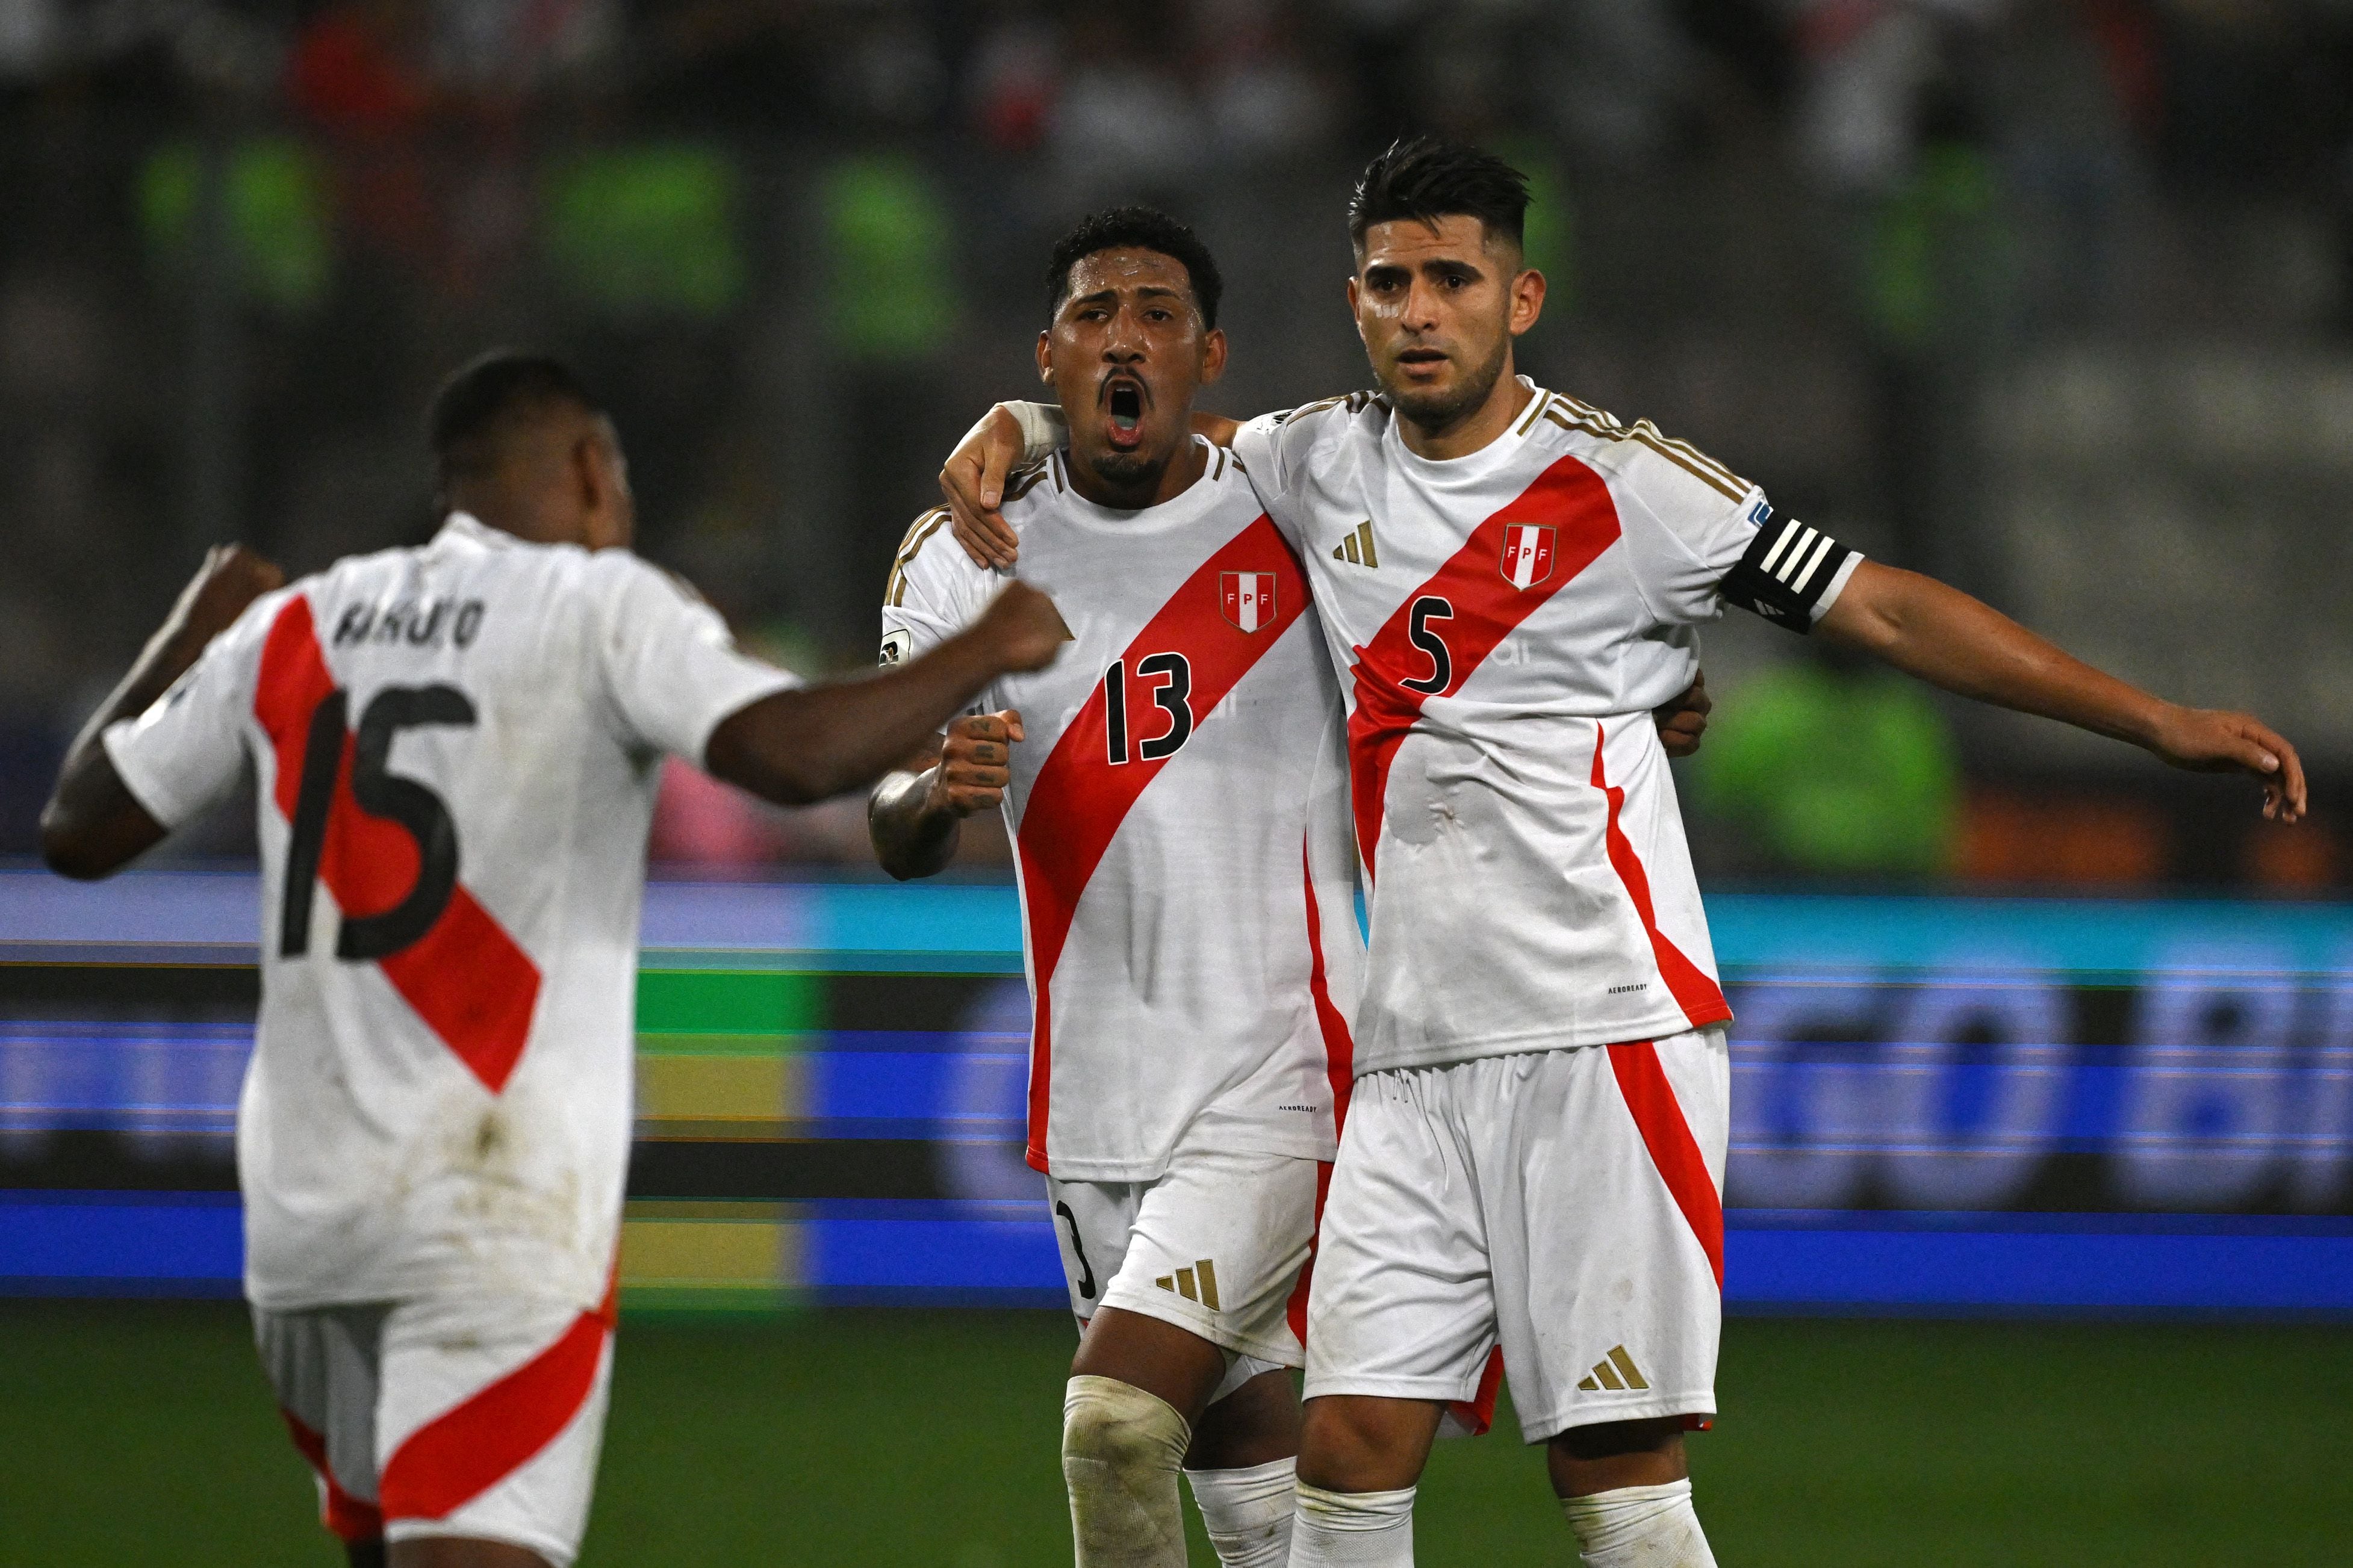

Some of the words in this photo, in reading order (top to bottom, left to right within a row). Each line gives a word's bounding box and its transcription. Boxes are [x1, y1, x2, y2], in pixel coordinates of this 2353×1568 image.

[1507, 545, 1548, 561] FPF
[1227, 593, 1269, 605] FPF
[1398, 595, 1454, 695] 5
[1104, 651, 1194, 766] 13
[279, 682, 478, 962] 15
[1608, 984, 1647, 994] AEROREADY
